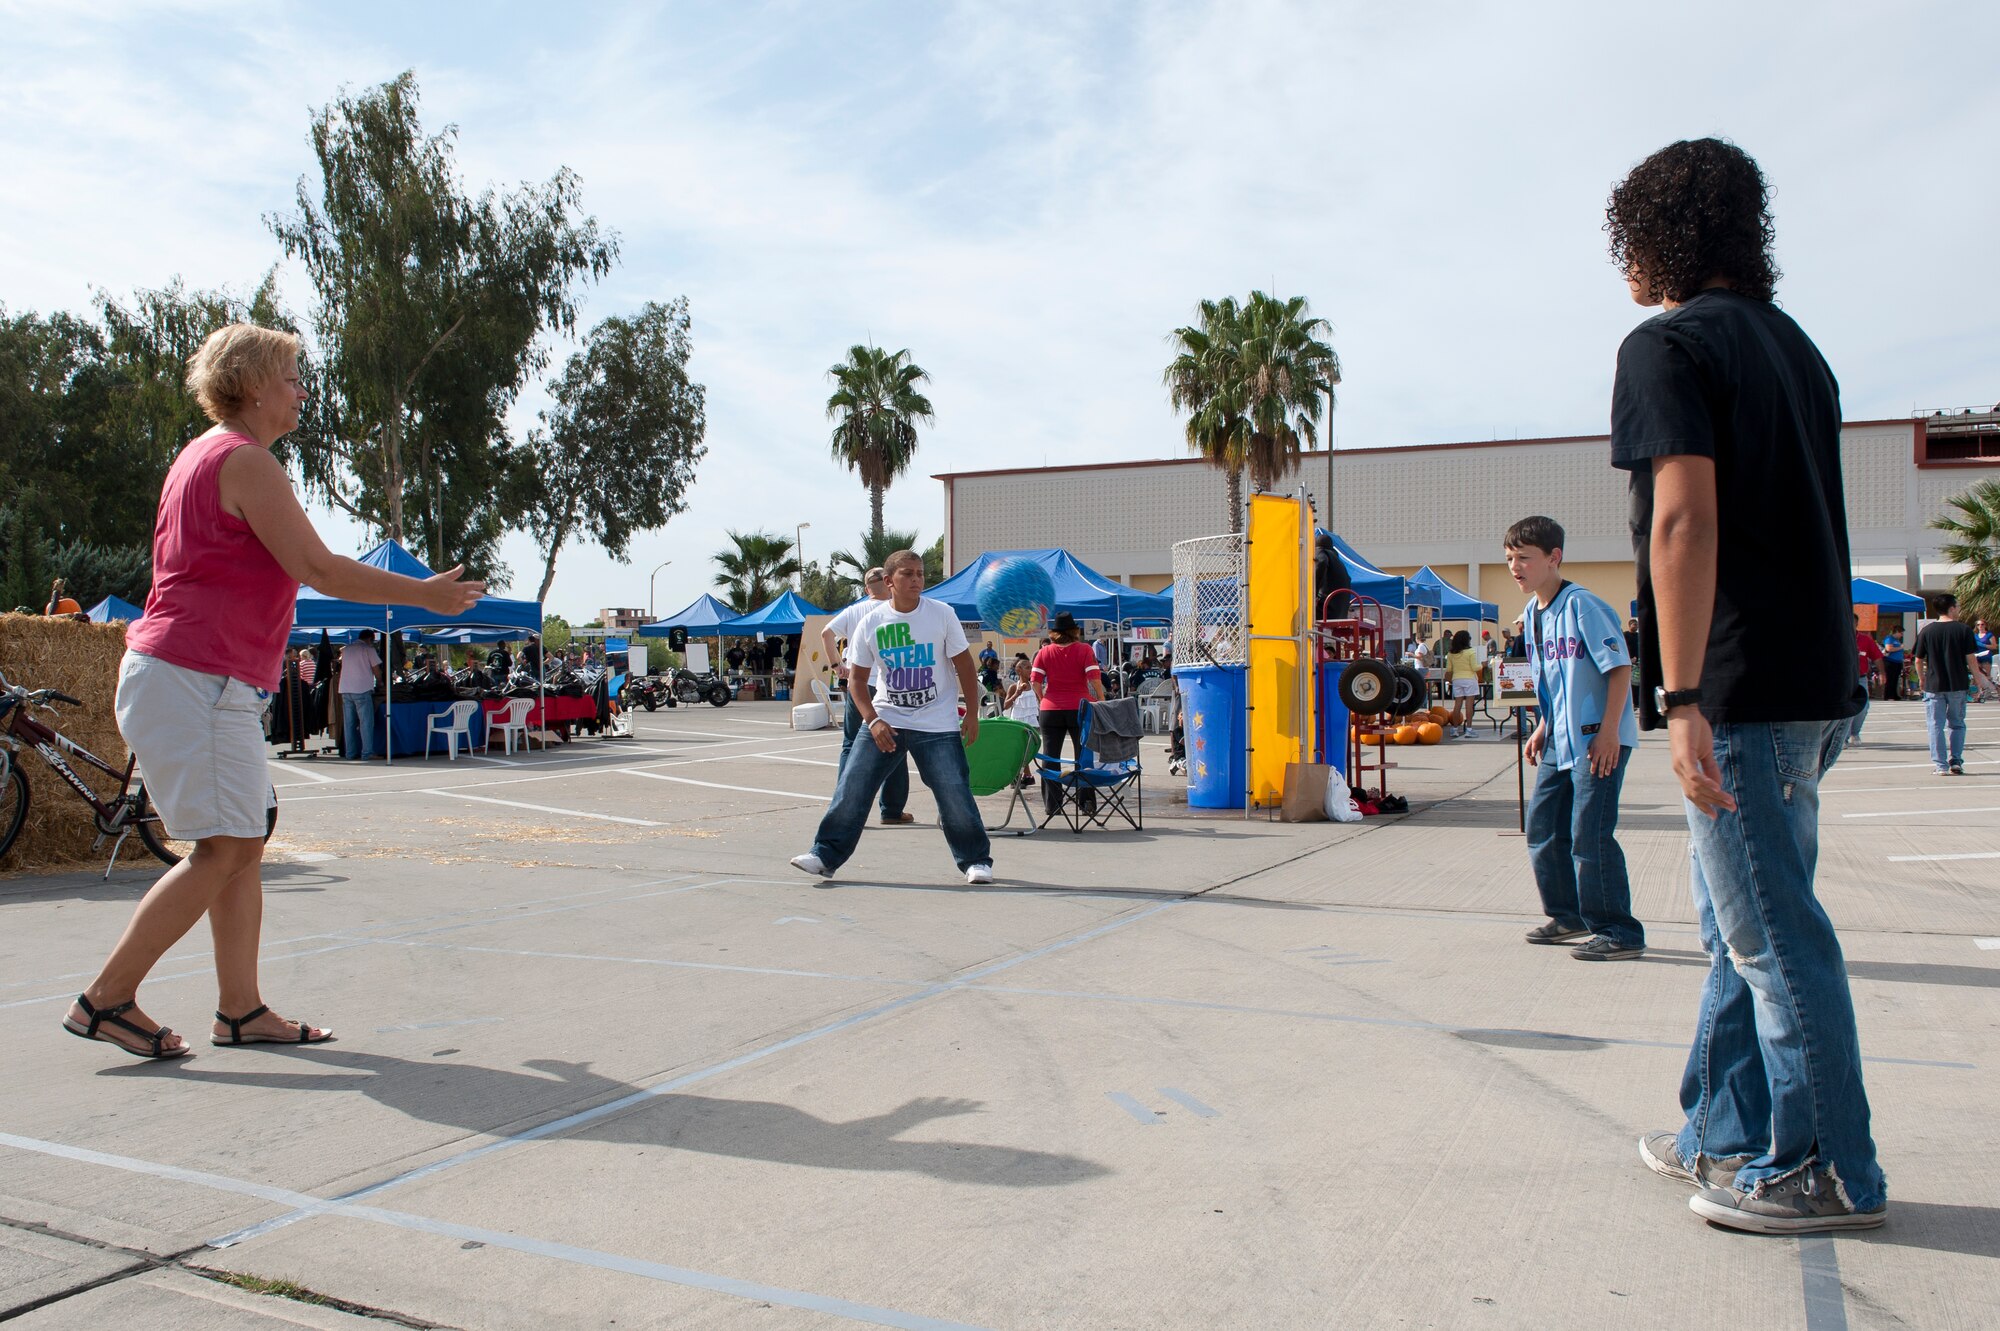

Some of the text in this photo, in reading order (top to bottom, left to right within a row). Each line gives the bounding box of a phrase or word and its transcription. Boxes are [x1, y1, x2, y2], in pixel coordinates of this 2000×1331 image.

[876, 622, 916, 650] MR.
[879, 642, 936, 670] STEAL
[888, 689, 936, 706] GIRL
[34, 741, 97, 802] SCHWINN
